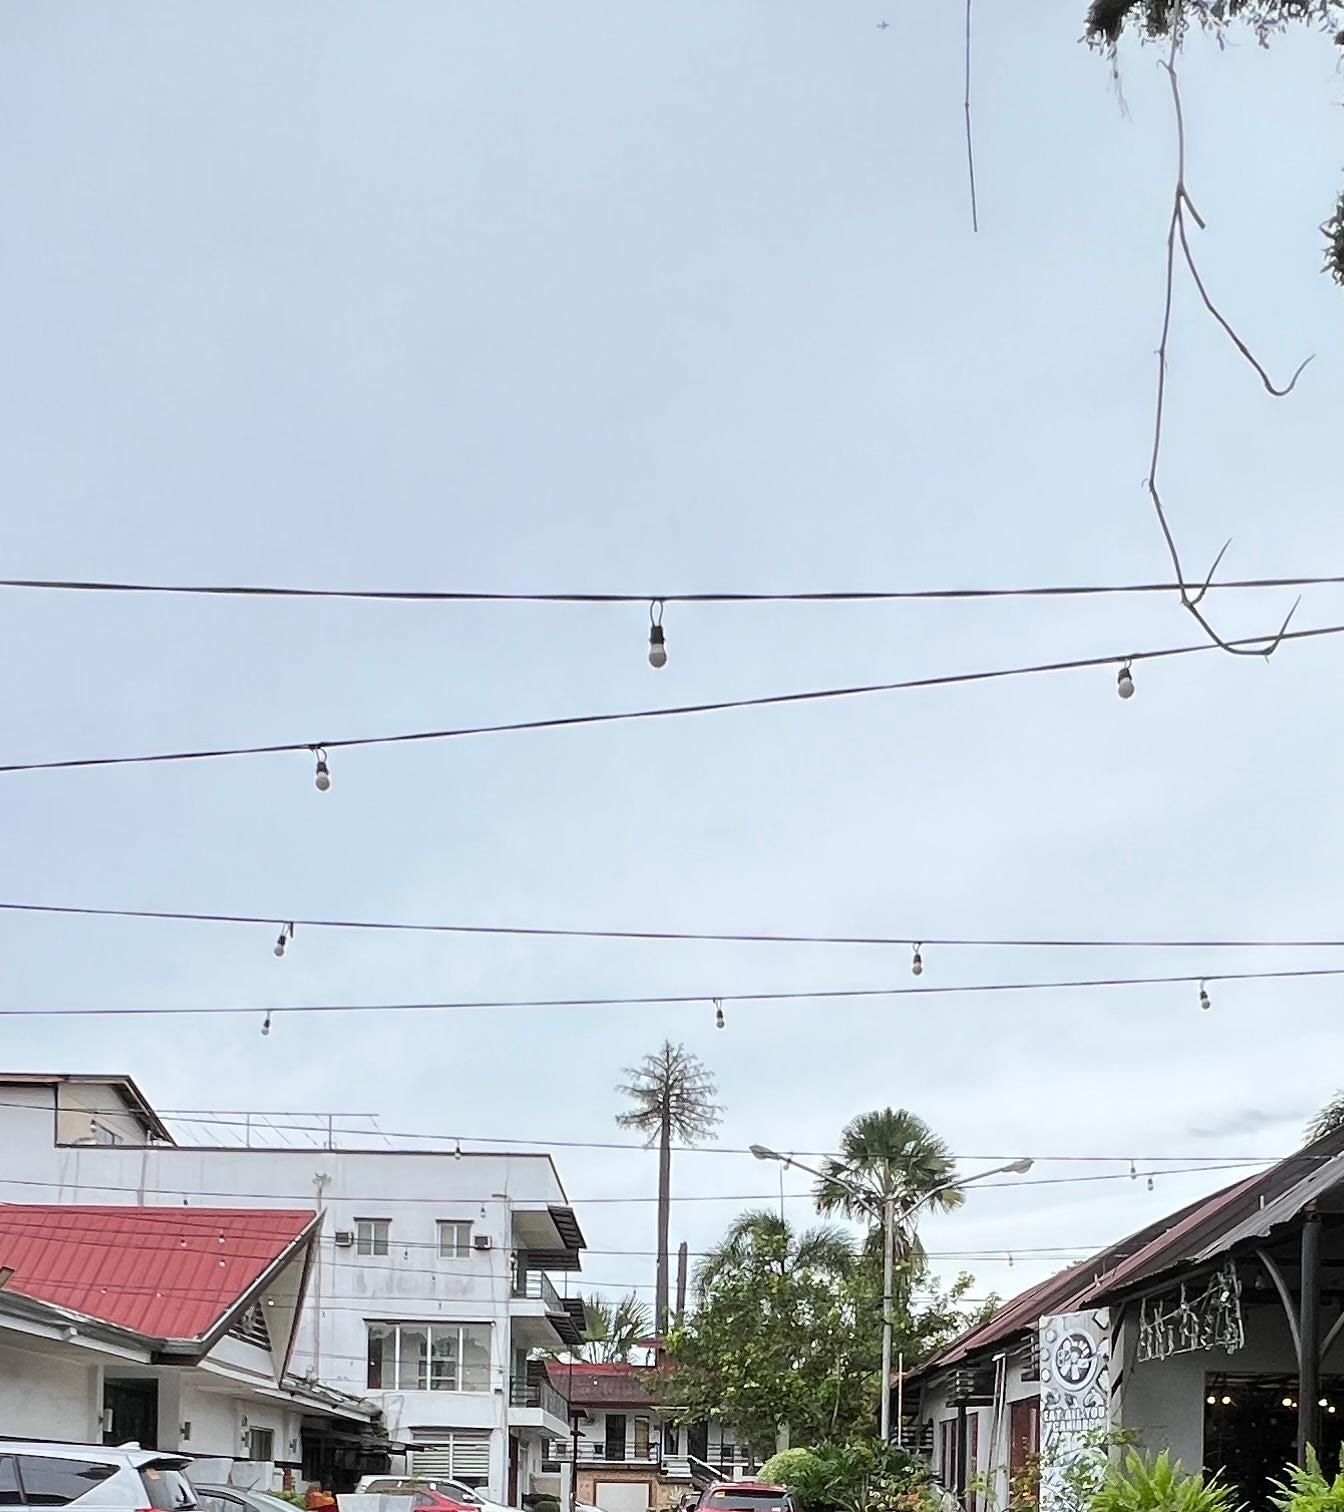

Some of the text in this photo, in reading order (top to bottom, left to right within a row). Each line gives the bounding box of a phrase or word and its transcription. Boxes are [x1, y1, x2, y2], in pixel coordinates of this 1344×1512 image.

[1043, 1406, 1105, 1422] EAT ALL YOU
